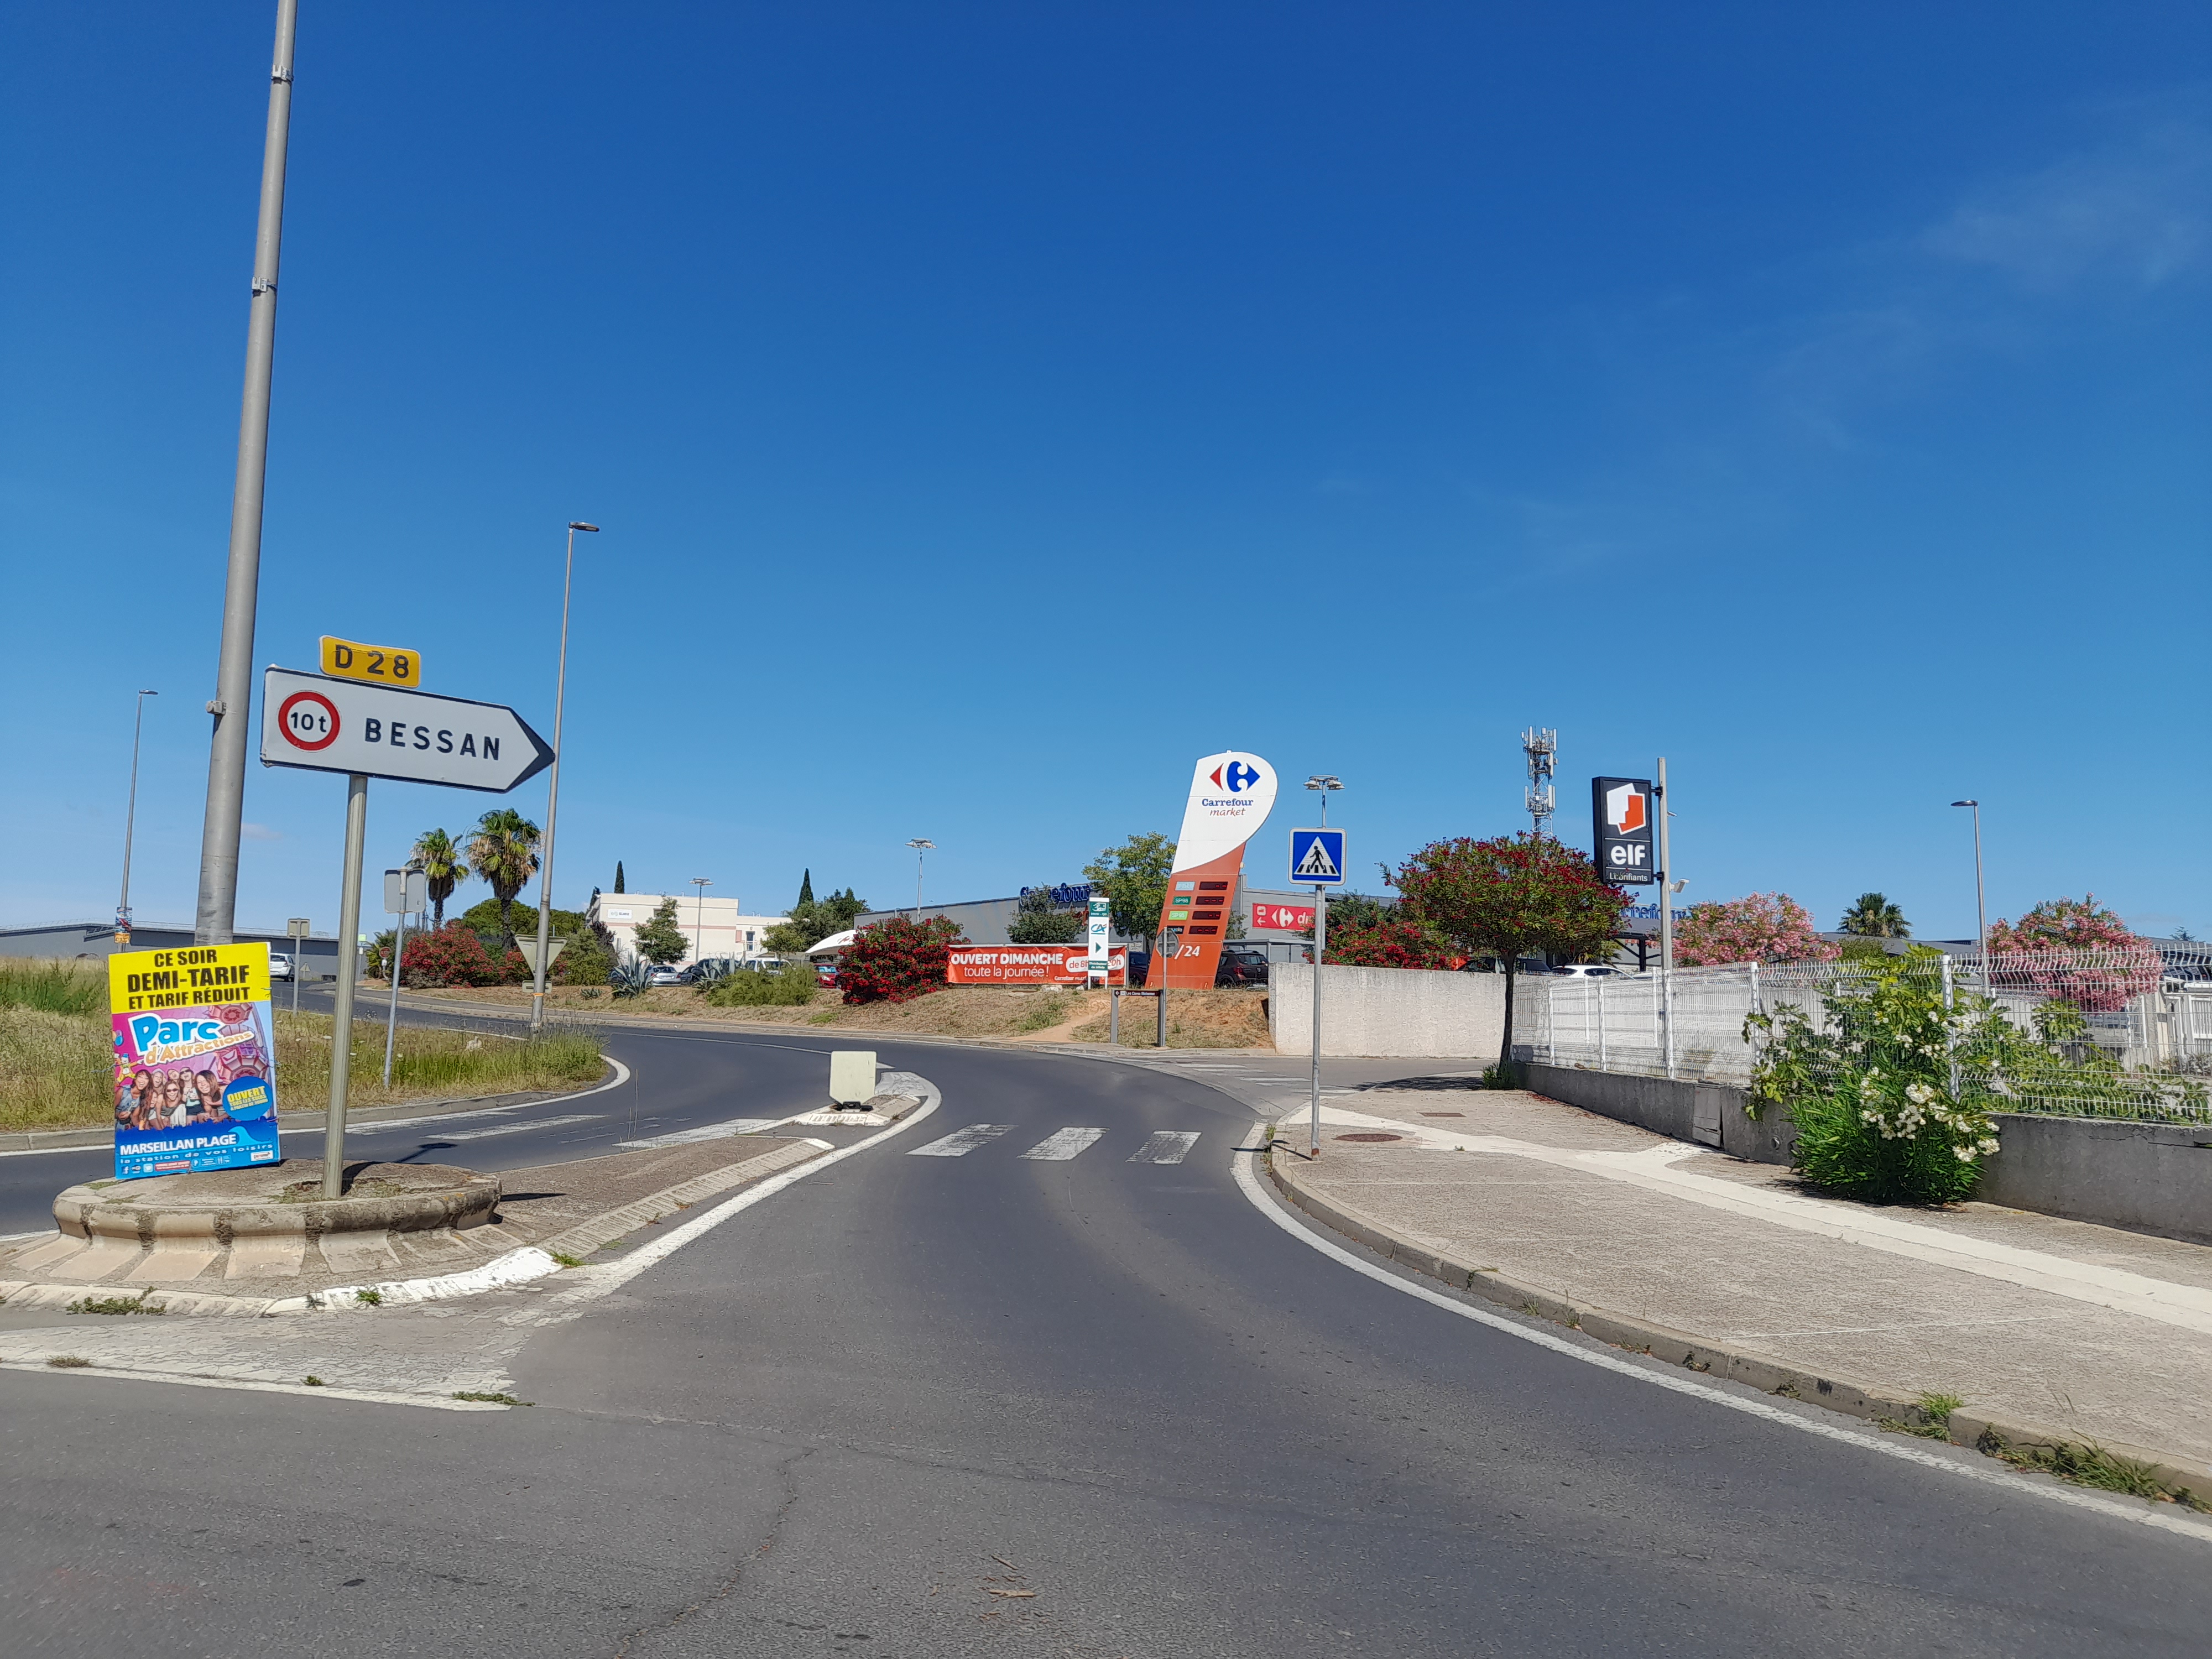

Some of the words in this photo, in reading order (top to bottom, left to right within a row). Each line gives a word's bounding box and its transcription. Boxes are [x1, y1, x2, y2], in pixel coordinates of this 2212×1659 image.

[335, 644, 353, 669] D
[367, 650, 409, 679] 28
[364, 717, 500, 761] BESSAN
[1202, 798, 1254, 806] Carrefour
[1209, 807, 1246, 817] market
[1610, 844, 1645, 865] elf
[154, 952, 174, 967] CE
[178, 949, 217, 966] SOIR
[951, 953, 998, 965] OUVERT
[1000, 953, 1063, 965] DIMANCHE
[1069, 959, 1079, 968] de
[127, 965, 250, 993] DEMI-TARIF
[964, 967, 992, 977] toute
[993, 966, 1001, 977] la
[129, 995, 144, 1010] ET
[148, 992, 189, 1008] TARIF
[192, 987, 250, 1004] RÉDUIT
[132, 1015, 222, 1052] Parc
[145, 1031, 253, 1065] d'Attractions
[227, 1086, 265, 1102] OUVERT
[120, 1139, 194, 1156] MARSEILLAN
[196, 1134, 237, 1148] PLAGE
[135, 1155, 179, 1163] station
[233, 1143, 273, 1153] loisirs
